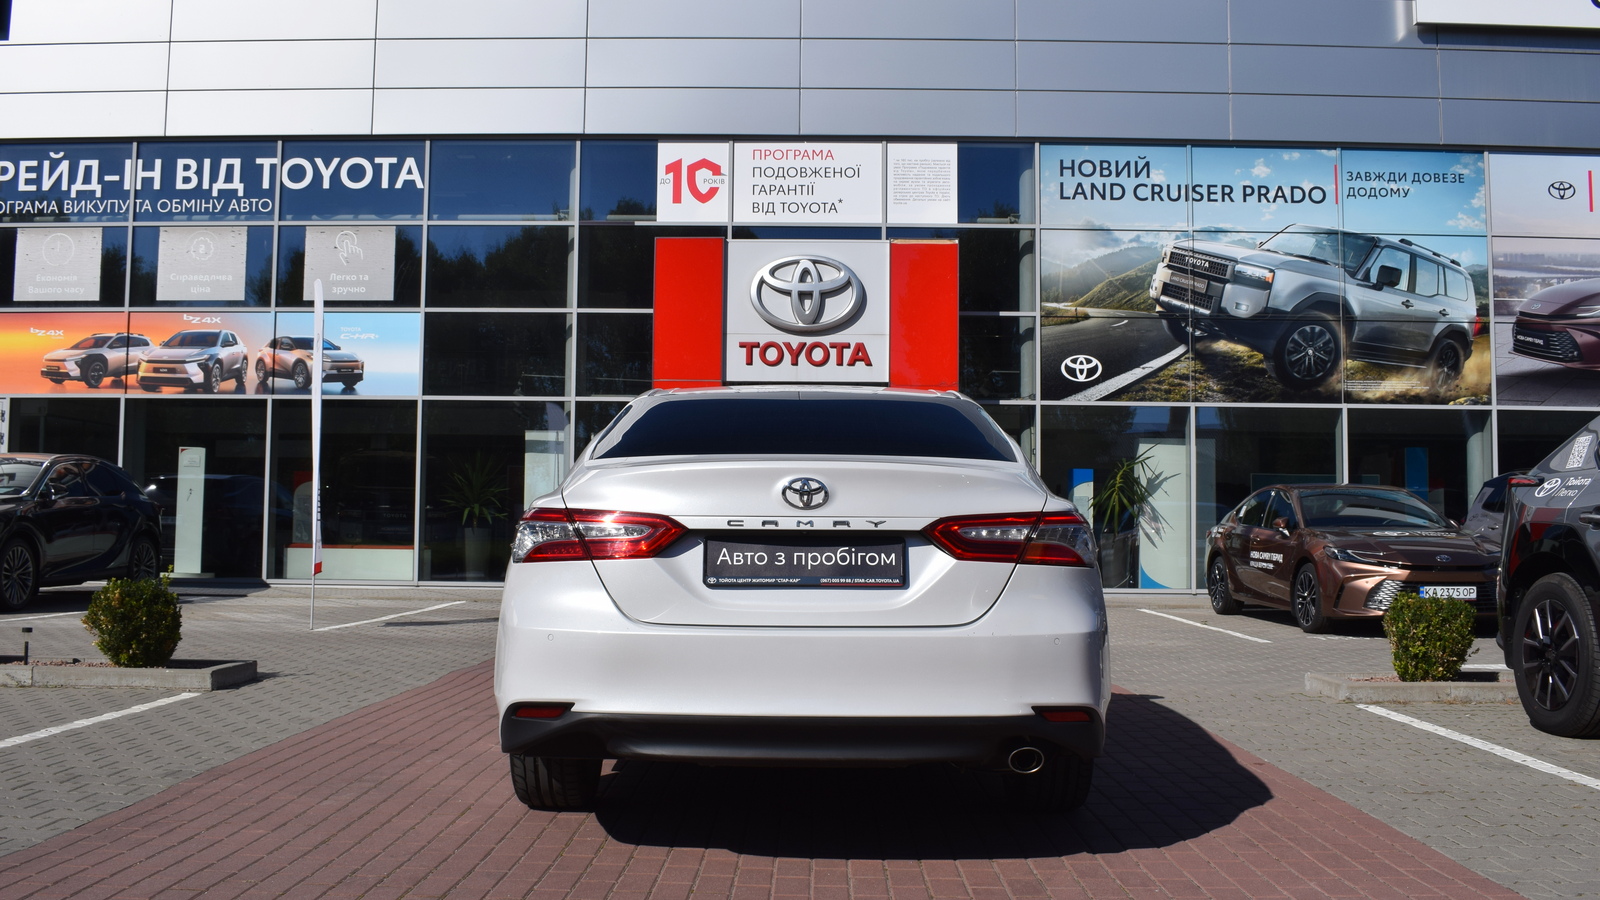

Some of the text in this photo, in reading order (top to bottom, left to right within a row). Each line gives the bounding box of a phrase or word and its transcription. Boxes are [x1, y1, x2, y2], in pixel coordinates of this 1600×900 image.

[752, 149, 835, 161] ПРОГРАМА
[752, 164, 862, 180] ПОДОВЖЕНОЇ
[1059, 155, 1151, 179] НОВИЙ
[175, 158, 245, 197] ВІД
[255, 156, 425, 190] TOYOTA
[1346, 171, 1465, 184] ЗАВЖДИ ДОВЕЗЕ
[752, 181, 816, 196] ГАРАНТІЇ
[1059, 181, 1327, 205] LAND CRUISER PRADO
[1346, 187, 1411, 199] ДОДОМУ
[63, 199, 130, 213] ВИКУПУ
[135, 199, 153, 213] ТА
[157, 198, 225, 213] ОБМІНУ
[228, 198, 273, 213] АВТО
[752, 202, 776, 216] ВІД
[1185, 257, 1209, 267] TOYOTA
[35, 274, 78, 282] Економія
[169, 273, 233, 283] Справедлива
[329, 273, 357, 281] Легко
[28, 286, 85, 296] Вашого часу
[190, 286, 211, 294] ціна
[332, 286, 366, 295] зручно
[183, 313, 222, 324] bZ4X
[30, 327, 65, 337] bZ4X
[738, 341, 873, 367] TOYOTA
[727, 520, 886, 528] CAMRY
[716, 547, 896, 569] Авто з пробігом
[1440, 588, 1461, 597] 2375
